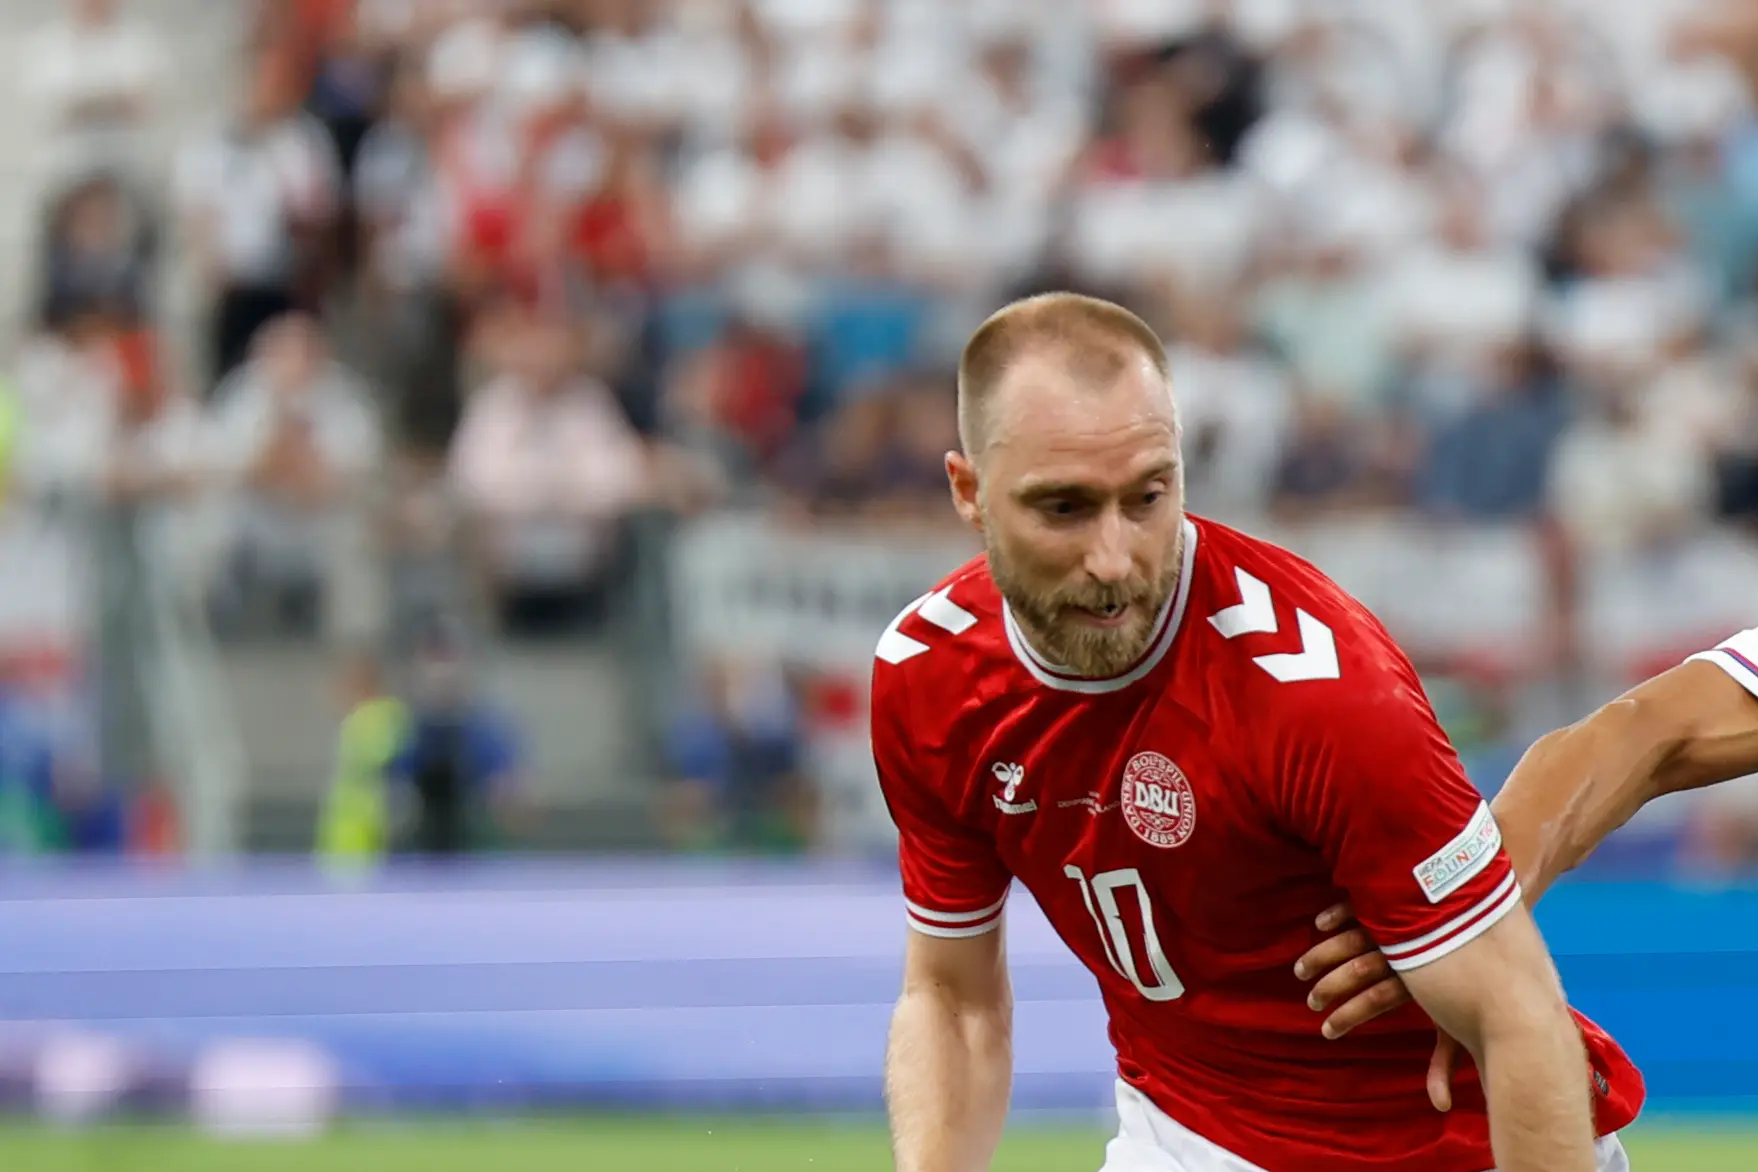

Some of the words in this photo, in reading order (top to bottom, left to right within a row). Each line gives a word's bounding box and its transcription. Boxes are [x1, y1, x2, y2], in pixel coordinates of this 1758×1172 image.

[1134, 780, 1180, 817] DBU
[1143, 827, 1176, 845] 1889
[1063, 864, 1185, 1002] 10
